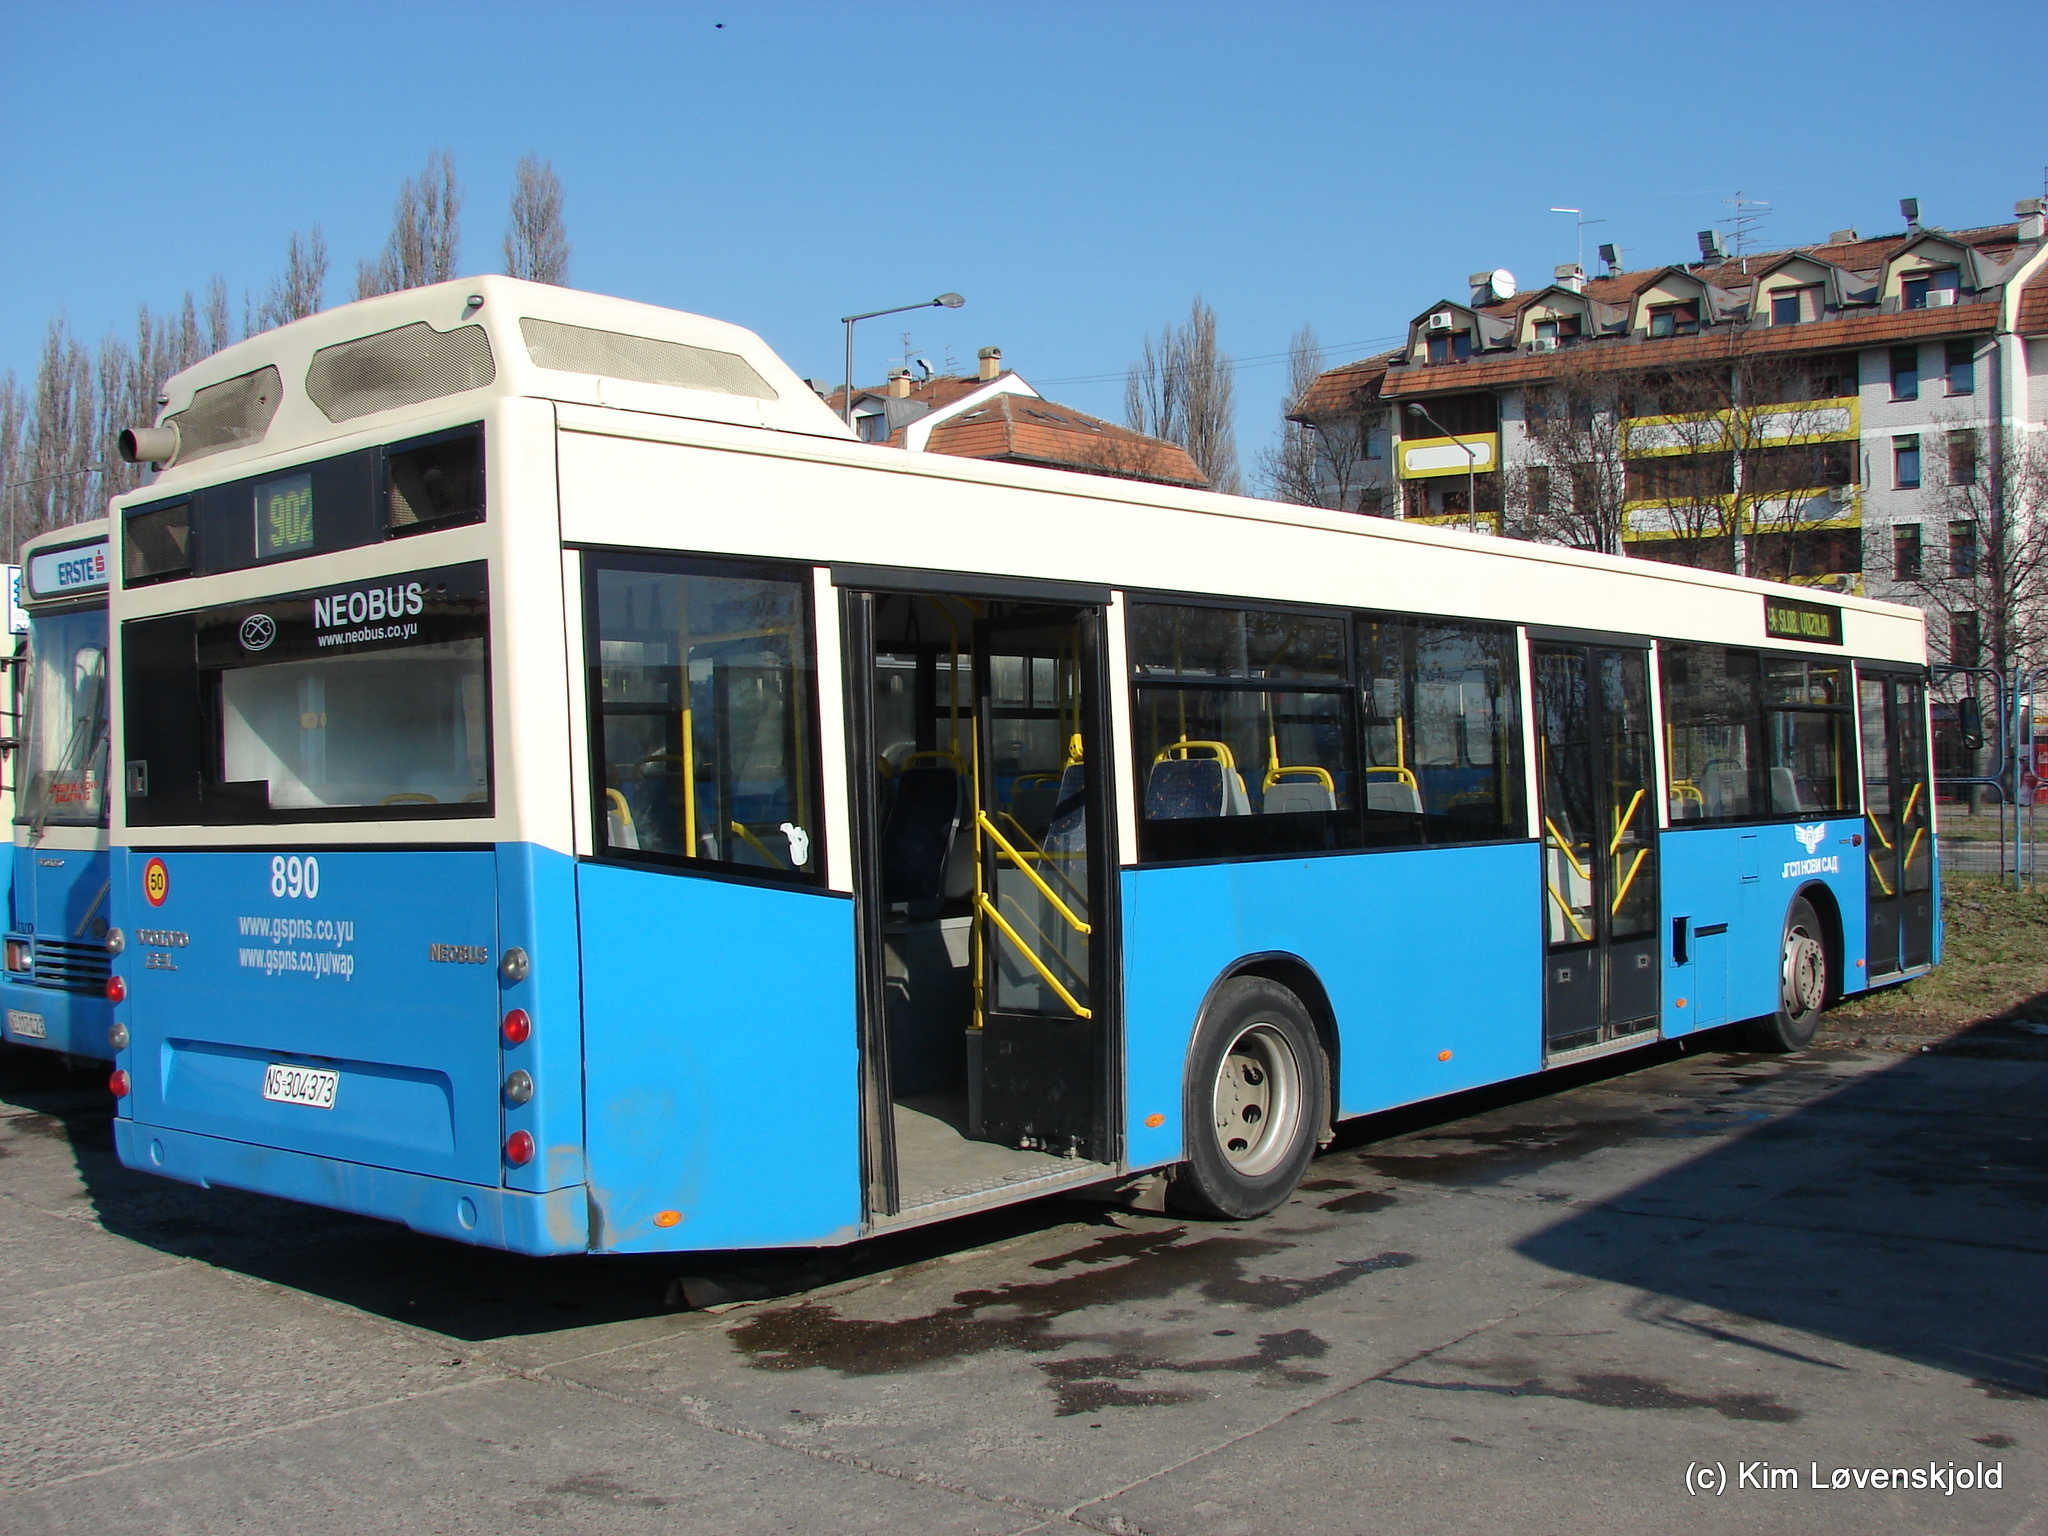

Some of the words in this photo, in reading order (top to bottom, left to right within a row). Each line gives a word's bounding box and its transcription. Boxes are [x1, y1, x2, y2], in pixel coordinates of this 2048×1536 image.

[58, 558, 95, 586] ERSTE
[314, 582, 424, 629] NEOBUS
[318, 622, 418, 647] www.neobus.co.yu
[271, 855, 320, 899] 890
[1801, 857, 1821, 874] НОВИ
[1821, 855, 1838, 874] САД
[150, 873, 164, 891] 50
[135, 928, 190, 948] VOLVO
[239, 916, 354, 948] www.gspns.co.yu
[239, 947, 355, 982] www.gspns.co.yu/wap
[429, 943, 488, 965] NEOBUS
